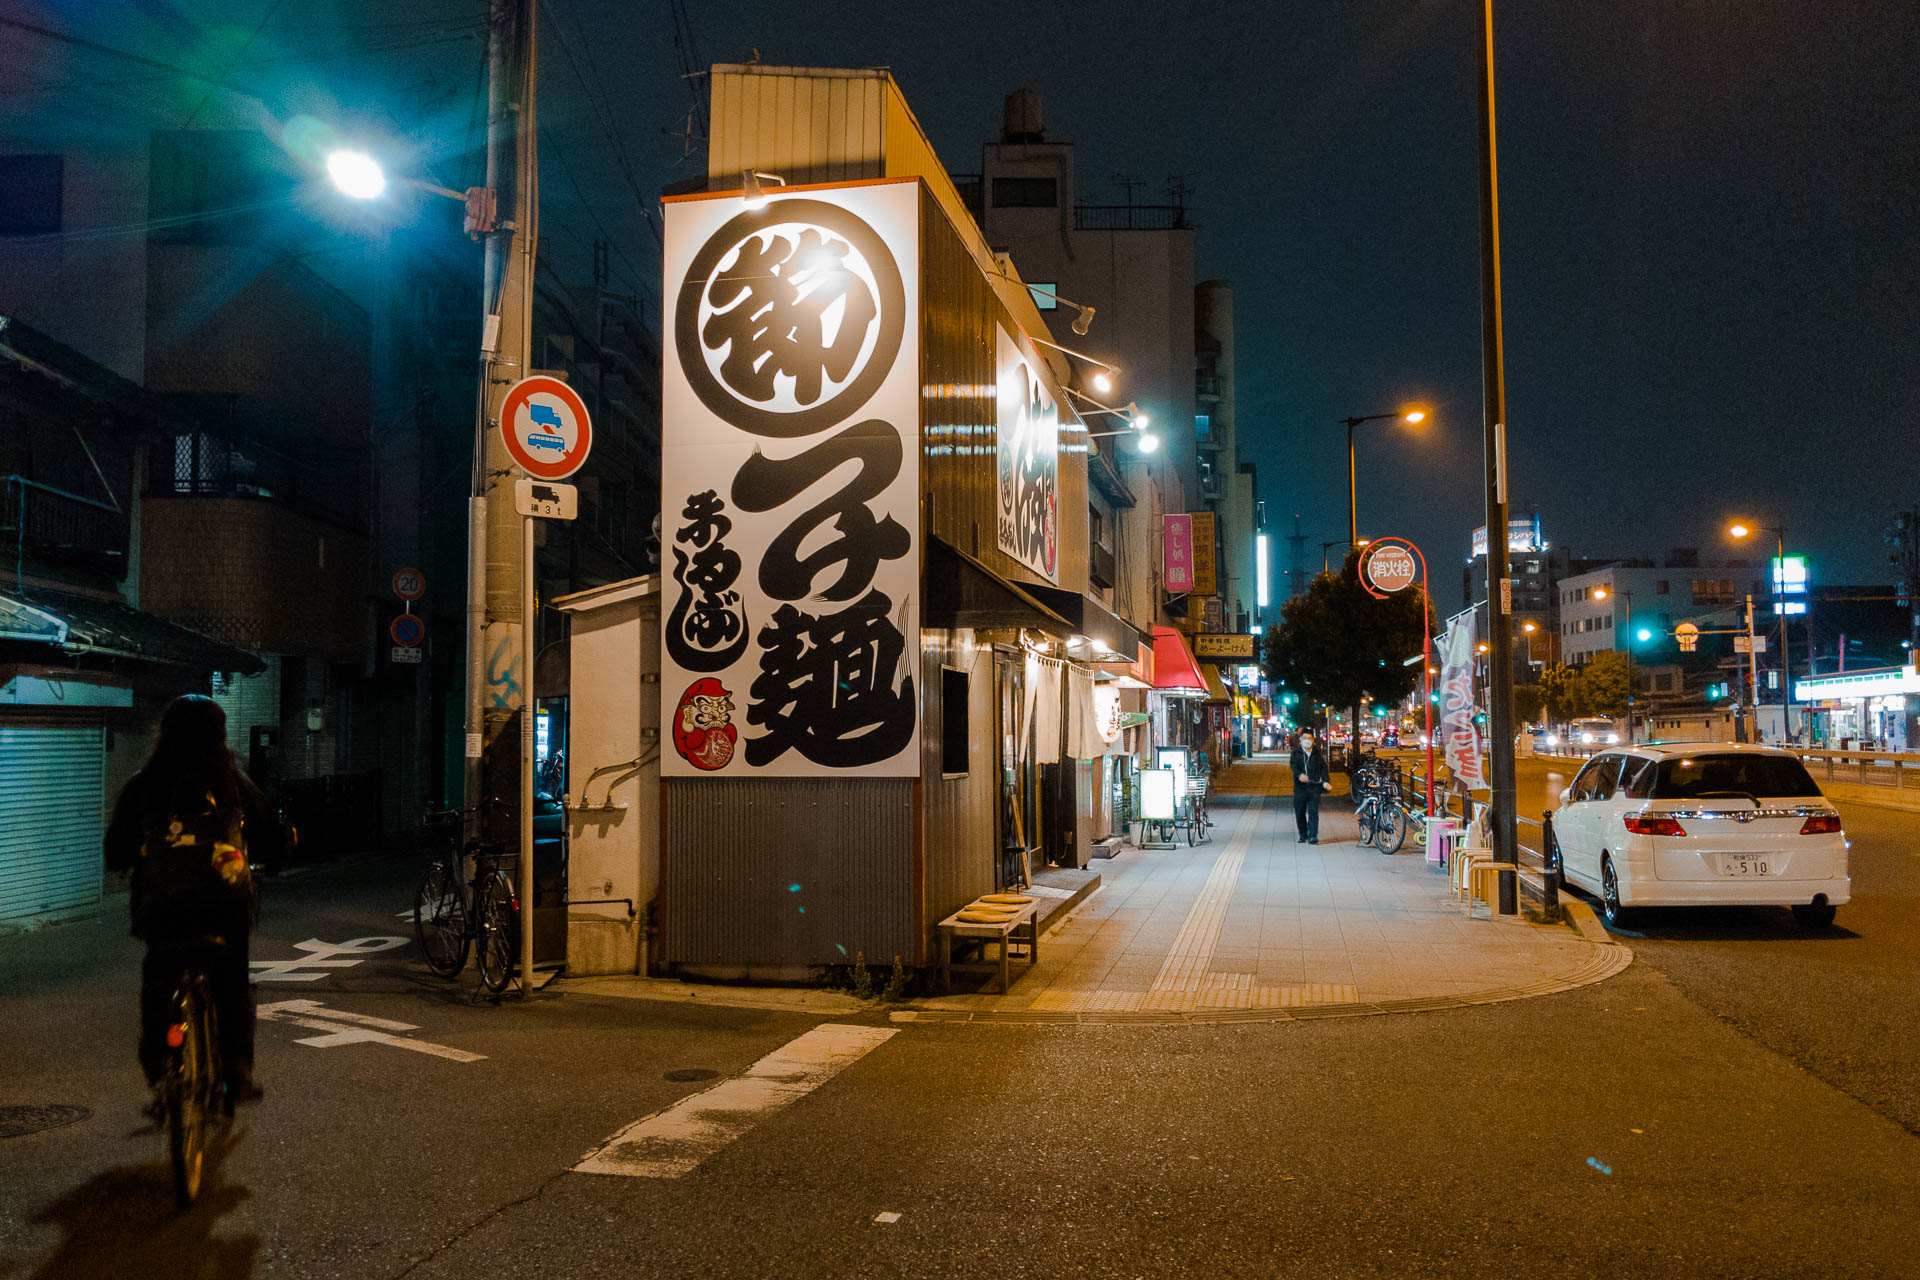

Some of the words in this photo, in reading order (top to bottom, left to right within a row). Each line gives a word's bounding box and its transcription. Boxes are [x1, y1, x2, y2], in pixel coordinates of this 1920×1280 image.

[1171, 523, 1184, 562] 癒し処
[1373, 559, 1410, 578] 消火栓
[398, 578, 418, 592] 20
[731, 418, 916, 767] つけ麺
[1199, 644, 1248, 653] めーよーけん
